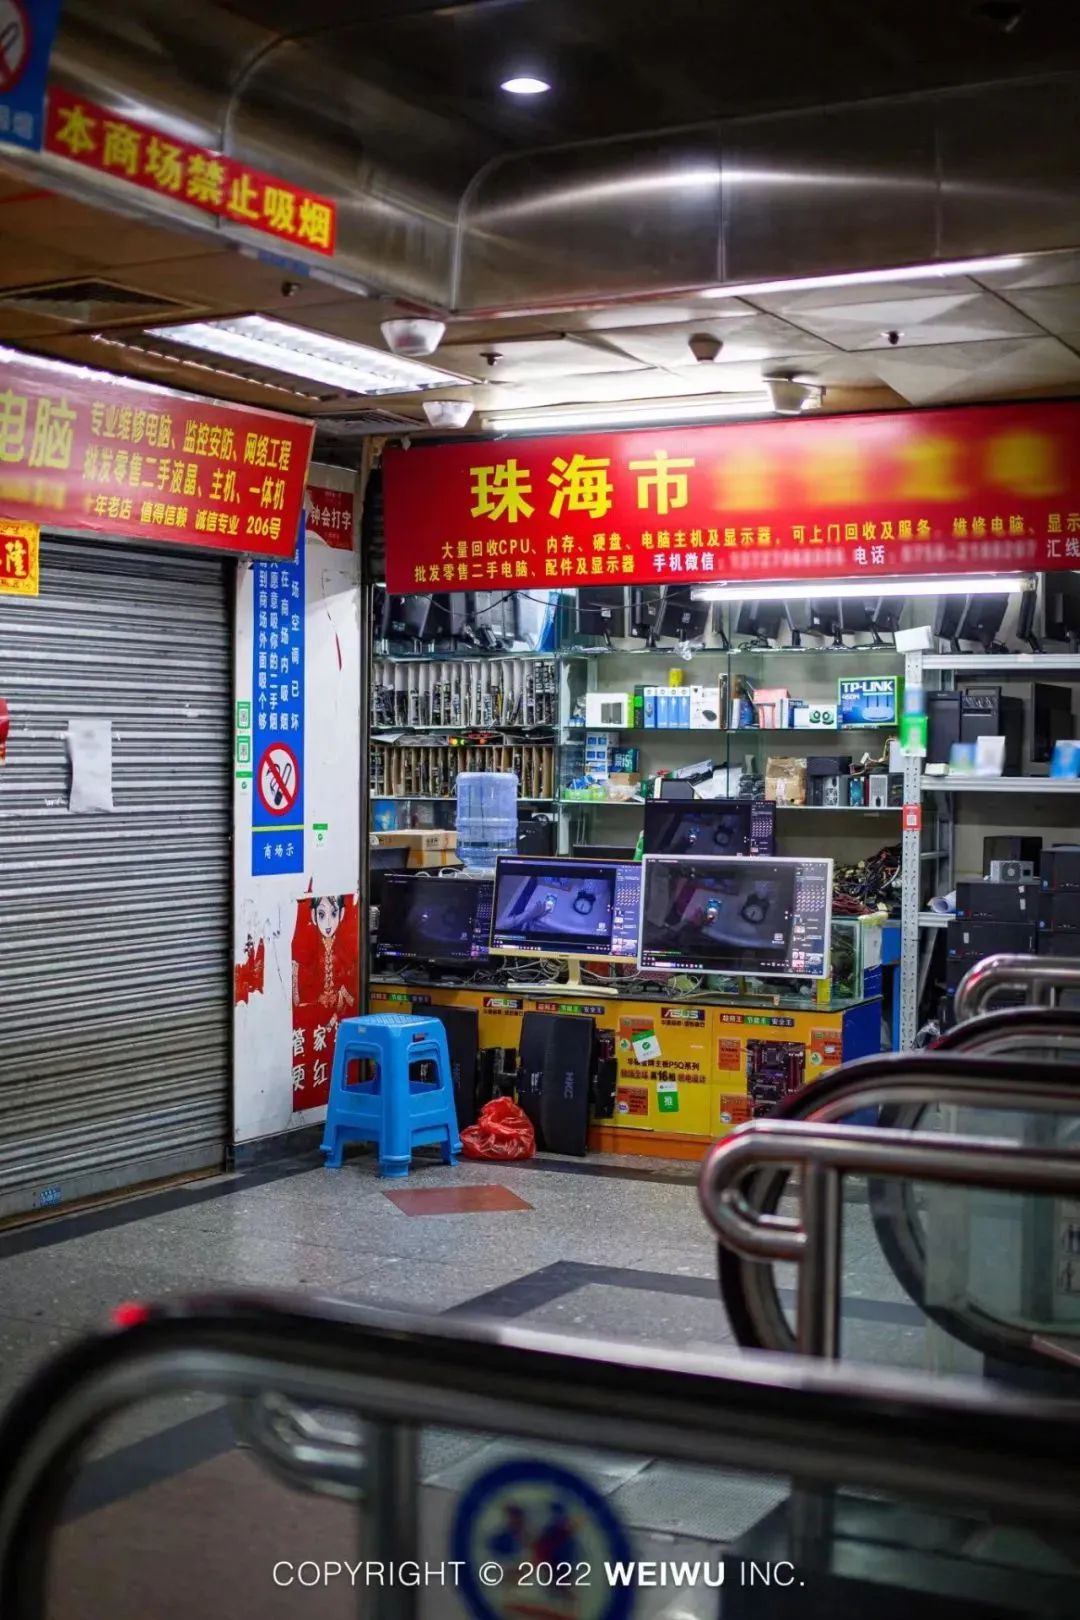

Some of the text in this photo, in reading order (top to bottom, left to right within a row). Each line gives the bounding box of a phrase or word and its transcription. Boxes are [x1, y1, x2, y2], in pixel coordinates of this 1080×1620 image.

[56, 105, 332, 248] 本商场禁止吸烟
[0, 389, 77, 470] 电脑
[470, 451, 695, 522] 珠海市
[141, 501, 188, 528] 值得信赖
[195, 508, 240, 535] 诚信专业
[246, 516, 282, 540] 206号
[653, 552, 714, 573] 手机微信
[855, 545, 885, 565] 电话
[842, 681, 893, 693] TP-LINK
[486, 998, 518, 1009] ASUS
[664, 1009, 699, 1019] ASUS
